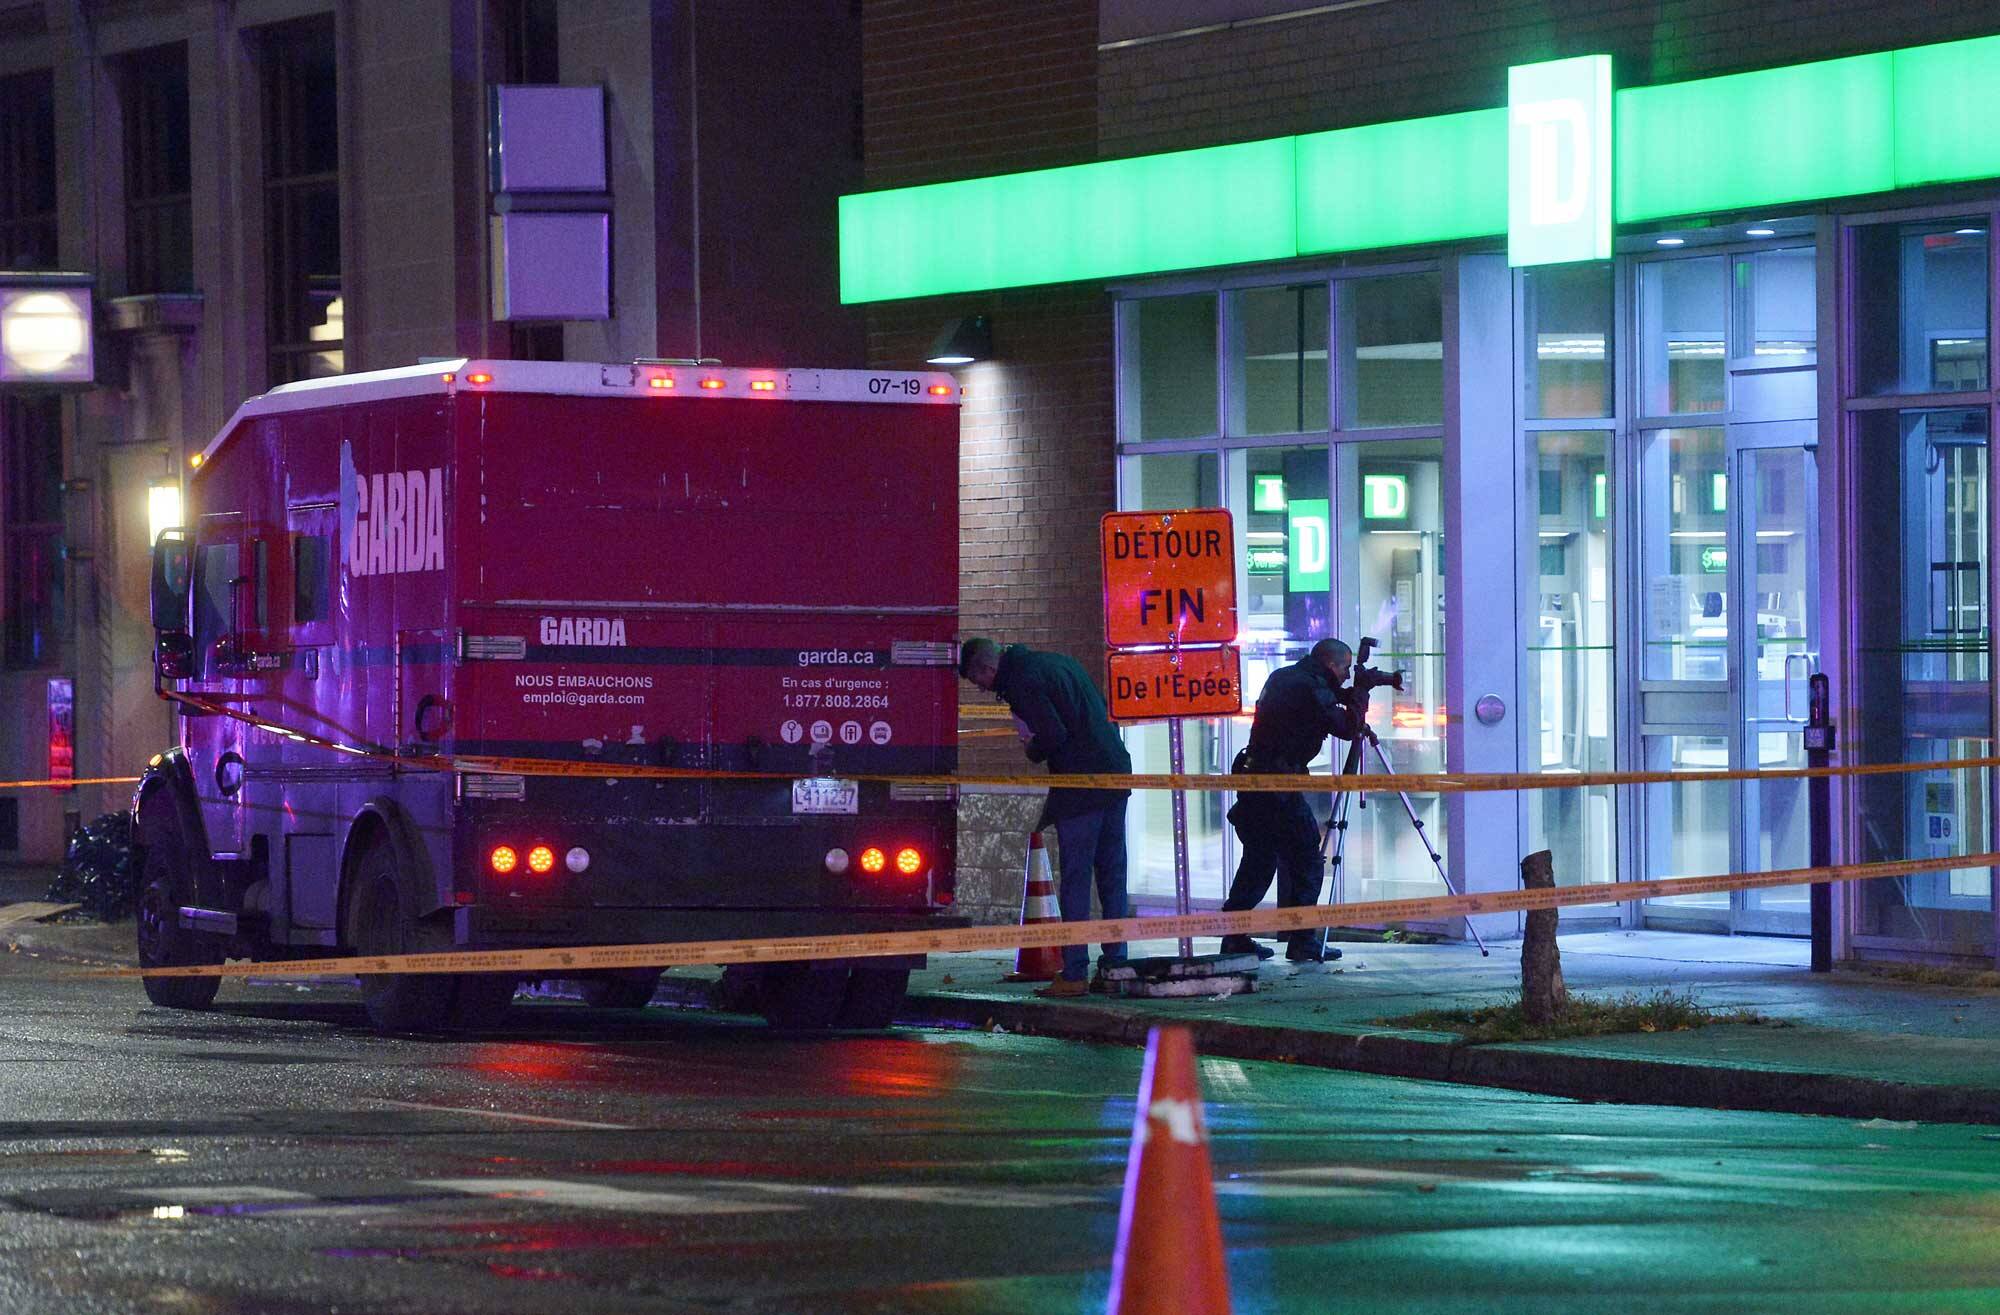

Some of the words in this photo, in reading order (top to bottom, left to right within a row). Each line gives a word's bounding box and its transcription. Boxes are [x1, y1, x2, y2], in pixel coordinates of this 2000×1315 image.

[1514, 98, 1591, 225] TD
[868, 378, 921, 395] 07-19
[1365, 477, 1407, 518] TD
[350, 467, 445, 578] GARDA
[1114, 525, 1221, 560] DÉTOUR
[1291, 516, 1327, 574] TD
[1140, 588, 1205, 626] FIN
[540, 616, 627, 647] GARDA
[798, 648, 875, 667] garda.ca
[515, 675, 554, 687] NOUS
[557, 675, 653, 688] EMBAUCHONS
[782, 677, 798, 688] En
[801, 679, 822, 688] cas
[825, 678, 882, 691] d'urgence
[1117, 676, 1148, 700] De
[1155, 668, 1231, 702] l'Épée
[523, 691, 645, 706] emploi@garda.com
[783, 694, 889, 708] 1.877.808.2864
[795, 787, 856, 806] L411237
